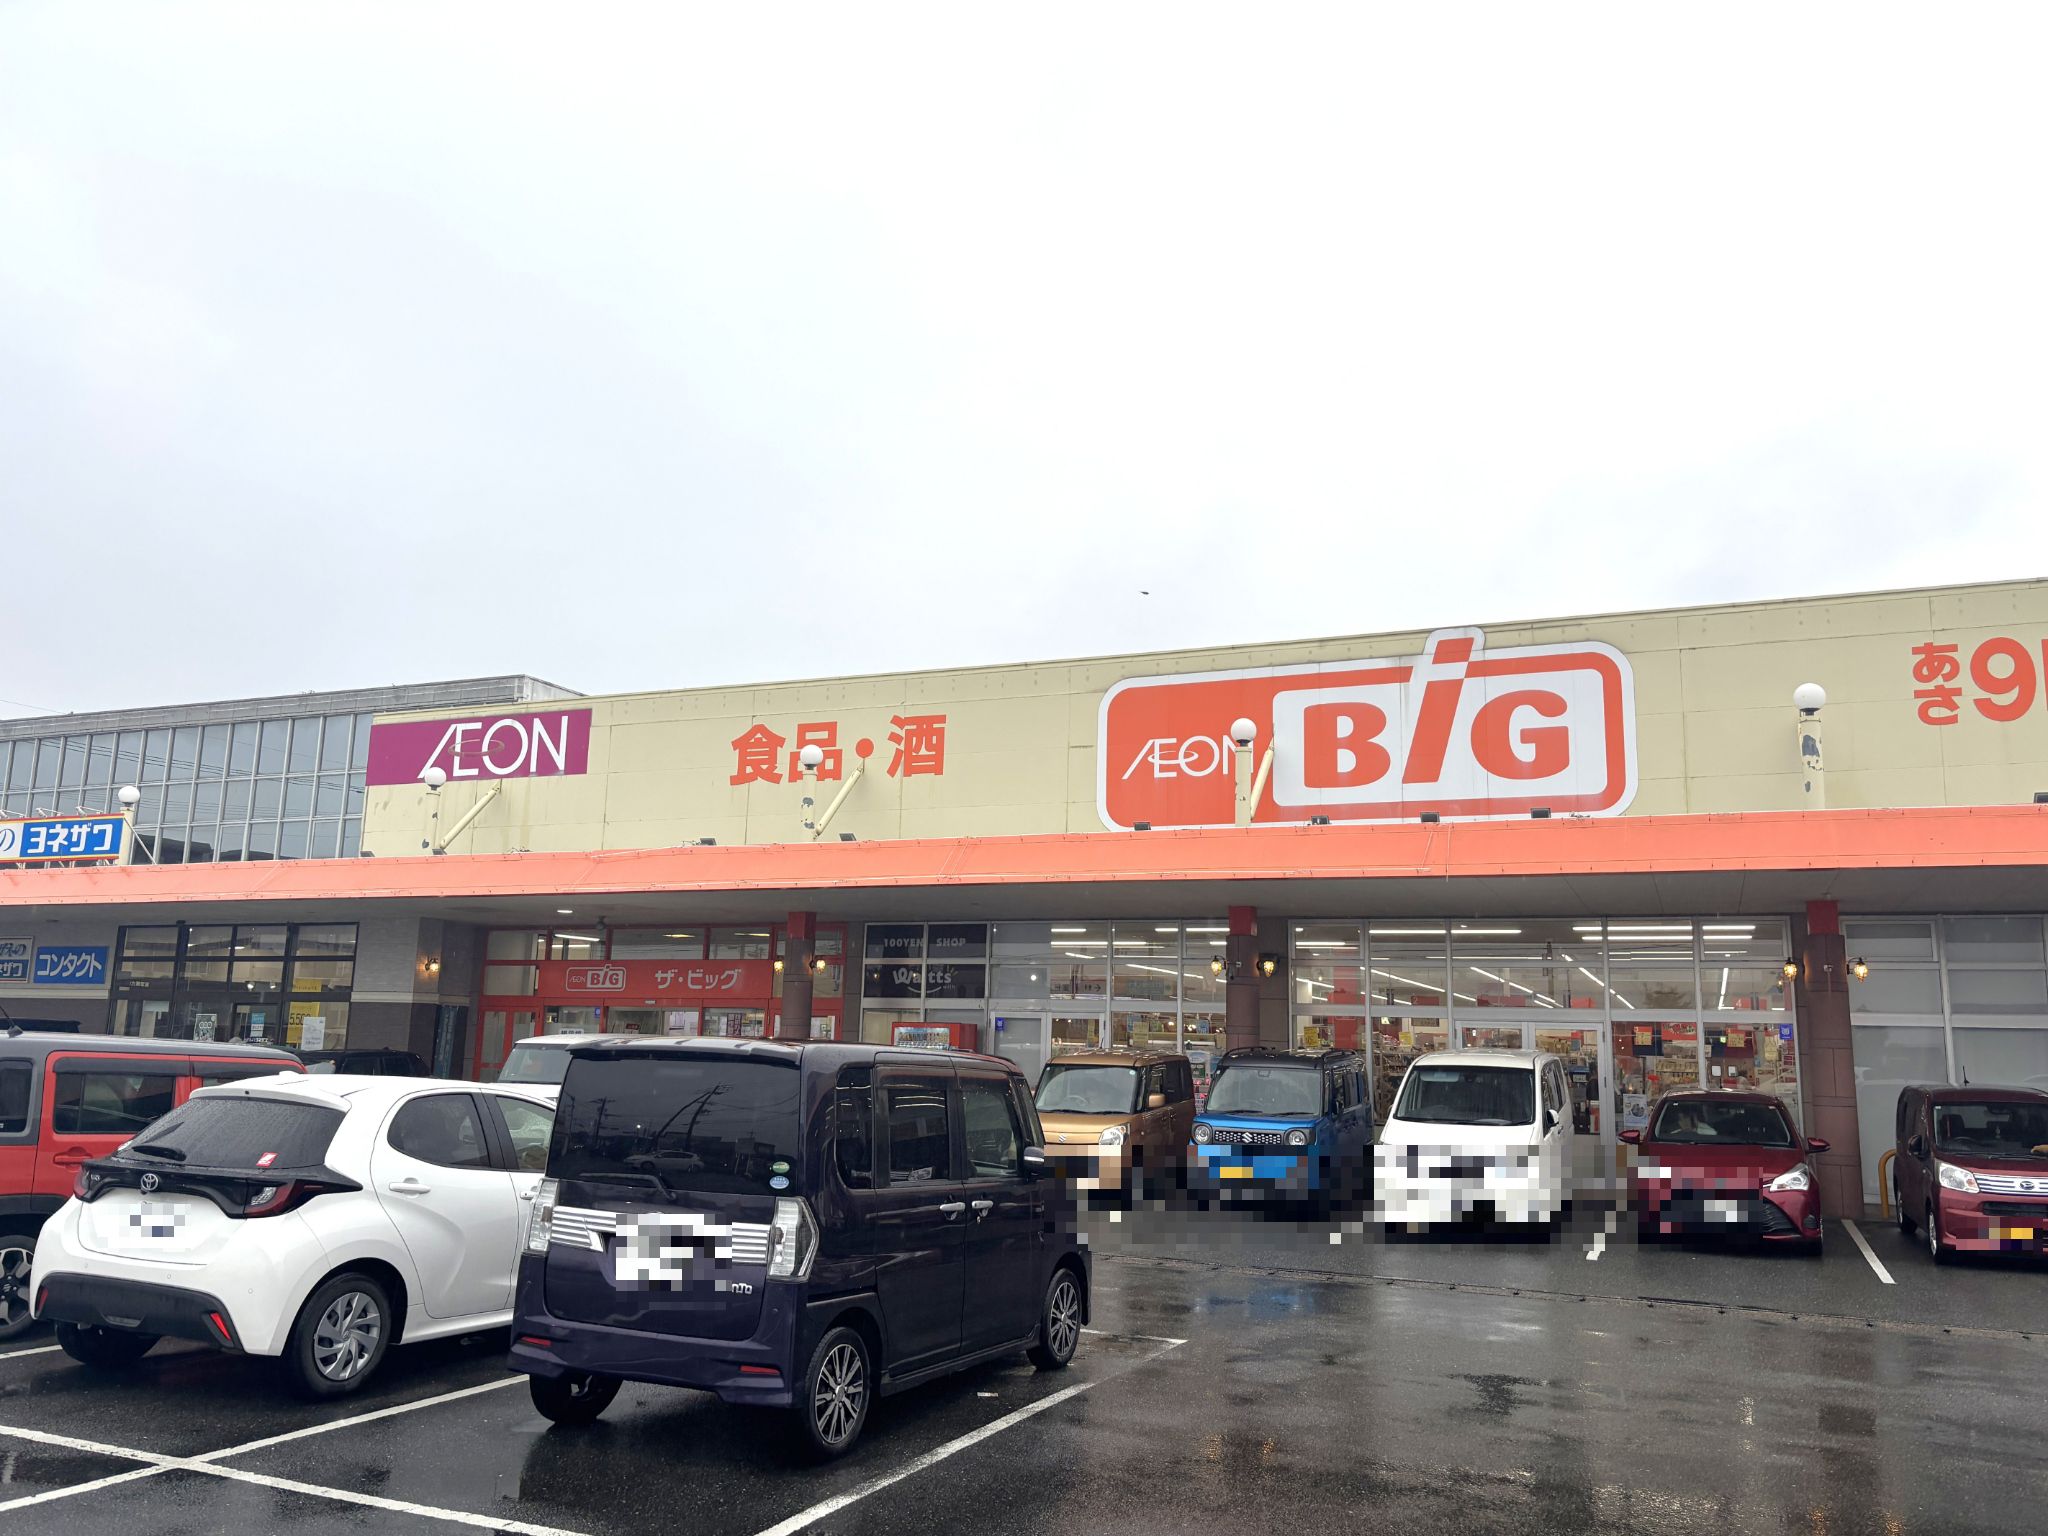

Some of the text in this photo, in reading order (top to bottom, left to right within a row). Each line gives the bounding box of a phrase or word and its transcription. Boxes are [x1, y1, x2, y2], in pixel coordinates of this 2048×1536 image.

[1970, 637, 2048, 722] 9
[1303, 637, 1569, 788] BiG
[27, 823, 113, 854] ヨネザワ
[936, 937, 966, 947] SHOP
[0, 962, 23, 977] ザワ
[37, 952, 102, 978] コンタクト
[592, 964, 620, 985] BiG
[655, 968, 741, 989] ザ・ビッグ
